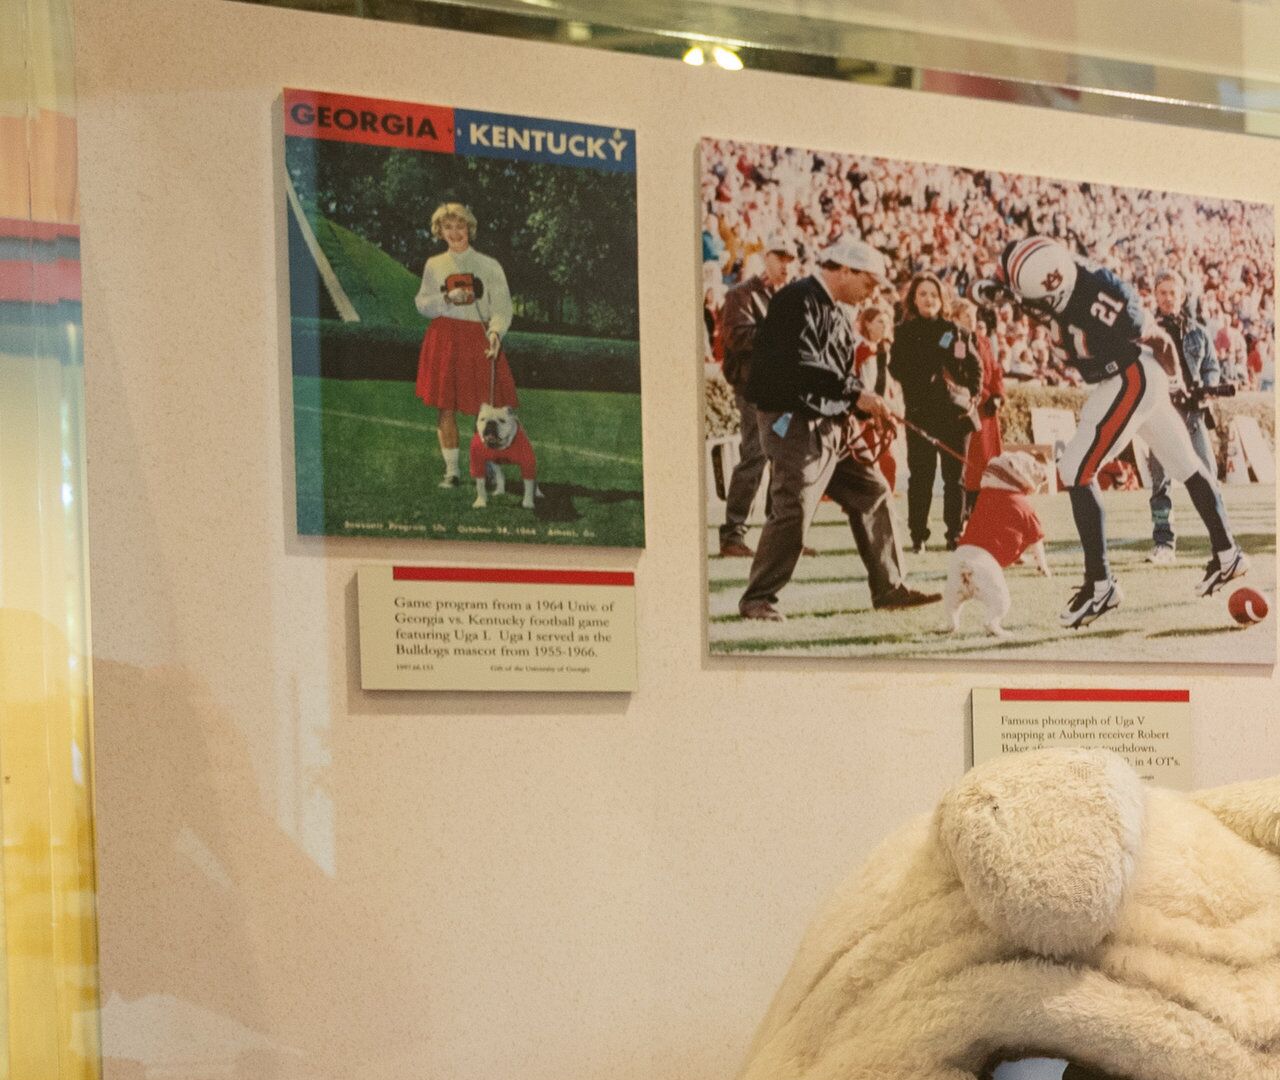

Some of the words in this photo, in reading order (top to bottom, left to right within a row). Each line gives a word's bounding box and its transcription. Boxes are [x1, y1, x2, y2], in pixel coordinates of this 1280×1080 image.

[290, 103, 439, 140] GEORGIA
[470, 123, 627, 161] KENTUCKY
[1090, 291, 1125, 327] 21
[395, 597, 432, 610] Game
[436, 601, 488, 611] program
[492, 599, 521, 610] from
[536, 600, 564, 611] 1964
[568, 601, 597, 612] Univ.
[601, 601, 614, 612] of
[395, 613, 444, 626] Georgia
[468, 614, 525, 628] Kentucky
[529, 615, 574, 627] football
[578, 619, 609, 629] game
[396, 628, 450, 642] featuring
[454, 630, 478, 642] Uga
[499, 630, 523, 643] Uga
[527, 630, 532, 641] I
[536, 631, 574, 642] served
[593, 631, 612, 642] the
[396, 644, 450, 658] Bulldogs
[453, 647, 496, 656] mascot
[501, 645, 530, 656] from
[534, 646, 598, 658] 1955-1966.
[526, 665, 555, 673] University
[1001, 716, 1039, 726] Famous
[1042, 716, 1098, 728] photograph
[1100, 716, 1112, 725] of
[1115, 716, 1134, 727] Uga
[1137, 716, 1145, 725] V
[1001, 731, 1045, 741] snapping
[1047, 731, 1056, 739] at
[1059, 730, 1096, 739] Auburn
[1098, 730, 1134, 739] receiver
[1138, 730, 1169, 739] Robert
[1001, 743, 1029, 753] Baker
[1135, 757, 1144, 766] in
[1147, 757, 1153, 766] 4
